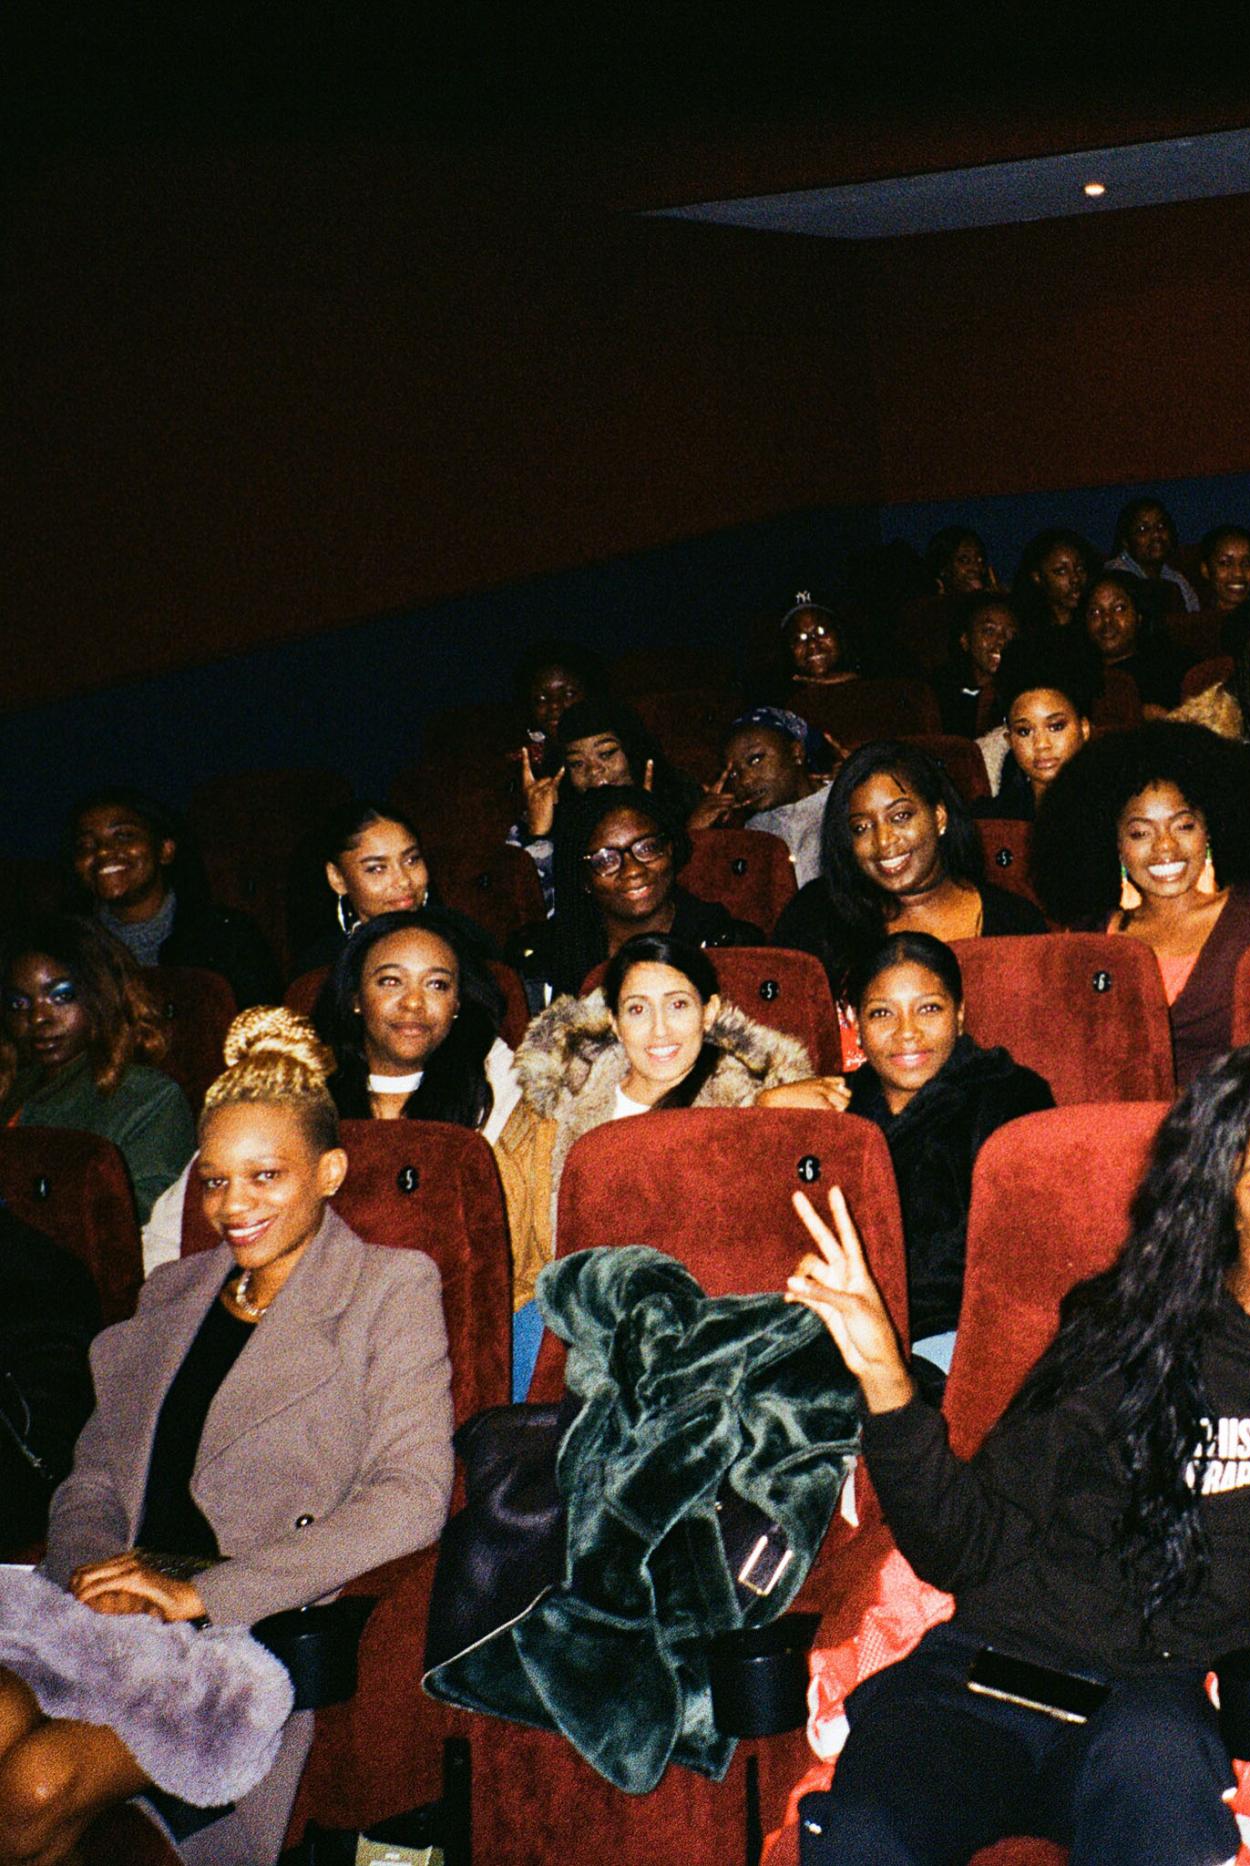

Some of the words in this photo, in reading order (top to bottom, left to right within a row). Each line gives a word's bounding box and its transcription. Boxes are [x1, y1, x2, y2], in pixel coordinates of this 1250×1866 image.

[1098, 973, 1106, 991] 6
[406, 1169, 413, 1190] 5
[805, 1160, 814, 1180] 6
